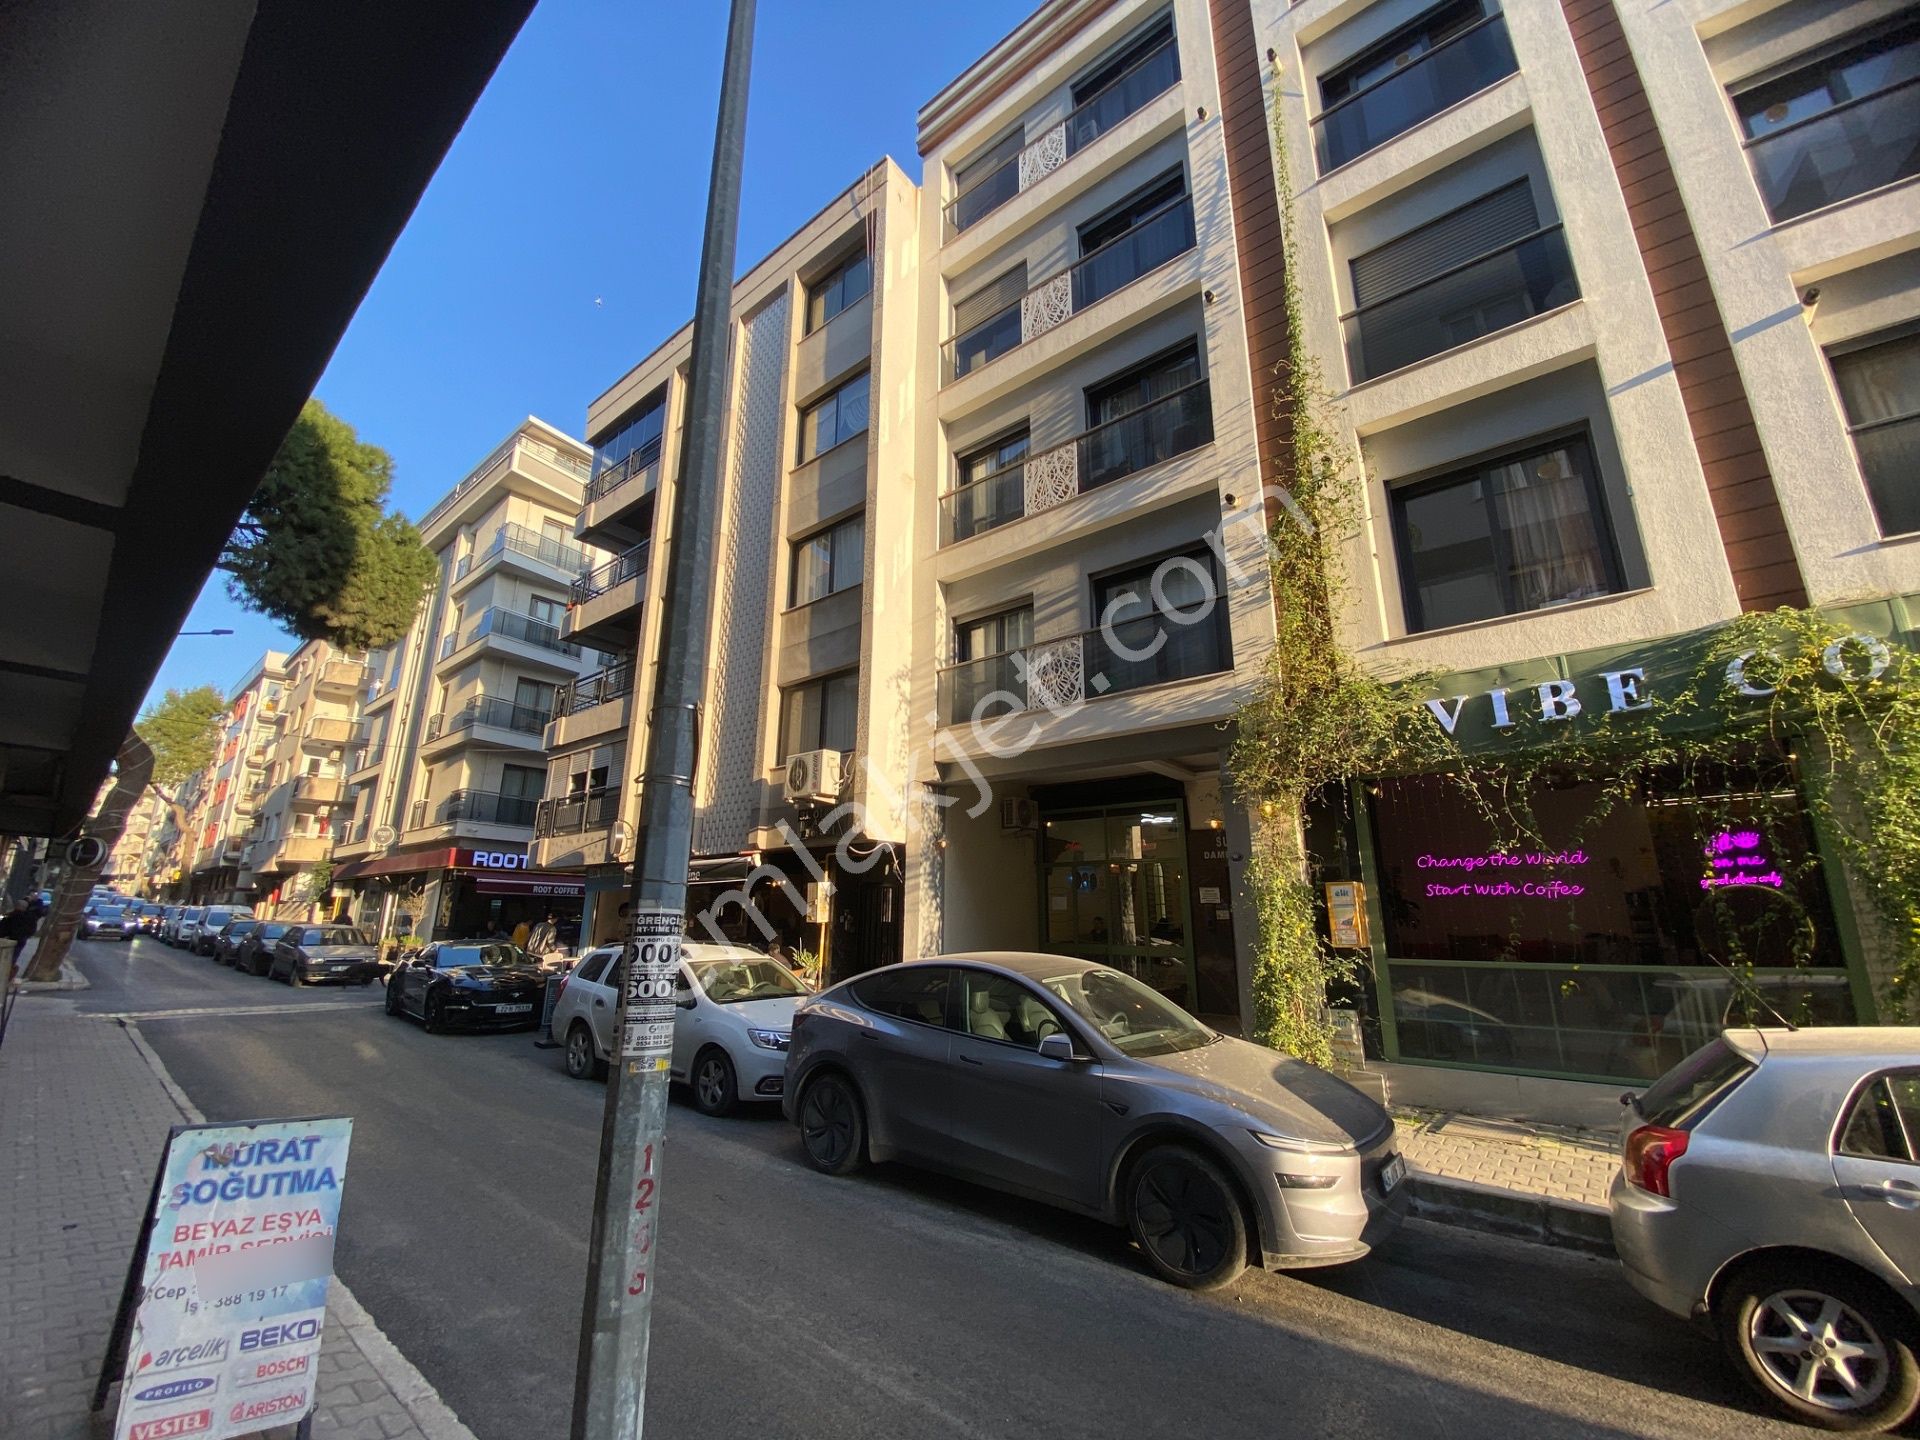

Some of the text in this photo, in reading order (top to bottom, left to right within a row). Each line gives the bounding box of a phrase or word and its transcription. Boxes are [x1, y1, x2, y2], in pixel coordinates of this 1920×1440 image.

[1424, 633, 1891, 736] VIBE CO
[473, 850, 529, 869] ROOT
[1417, 854, 1488, 872] Change
[1488, 853, 1522, 866] the
[533, 885, 579, 895] ROOT COFFEE
[1426, 880, 1585, 899] Start With Coffee
[202, 1135, 322, 1170] MURAT
[169, 1166, 337, 1211] SOĞUTMA
[173, 1216, 256, 1243] BEYAZ
[262, 1208, 322, 1233] EŞYA
[154, 1286, 187, 1300] Cep
[249, 1289, 266, 1303] 19
[271, 1285, 288, 1299] 17
[240, 1319, 318, 1350] BEKO
[155, 1337, 226, 1368] arçelik
[256, 1355, 307, 1378] BOSCH
[246, 1393, 304, 1418] ARISTON
[134, 1414, 206, 1440] VESTEL
